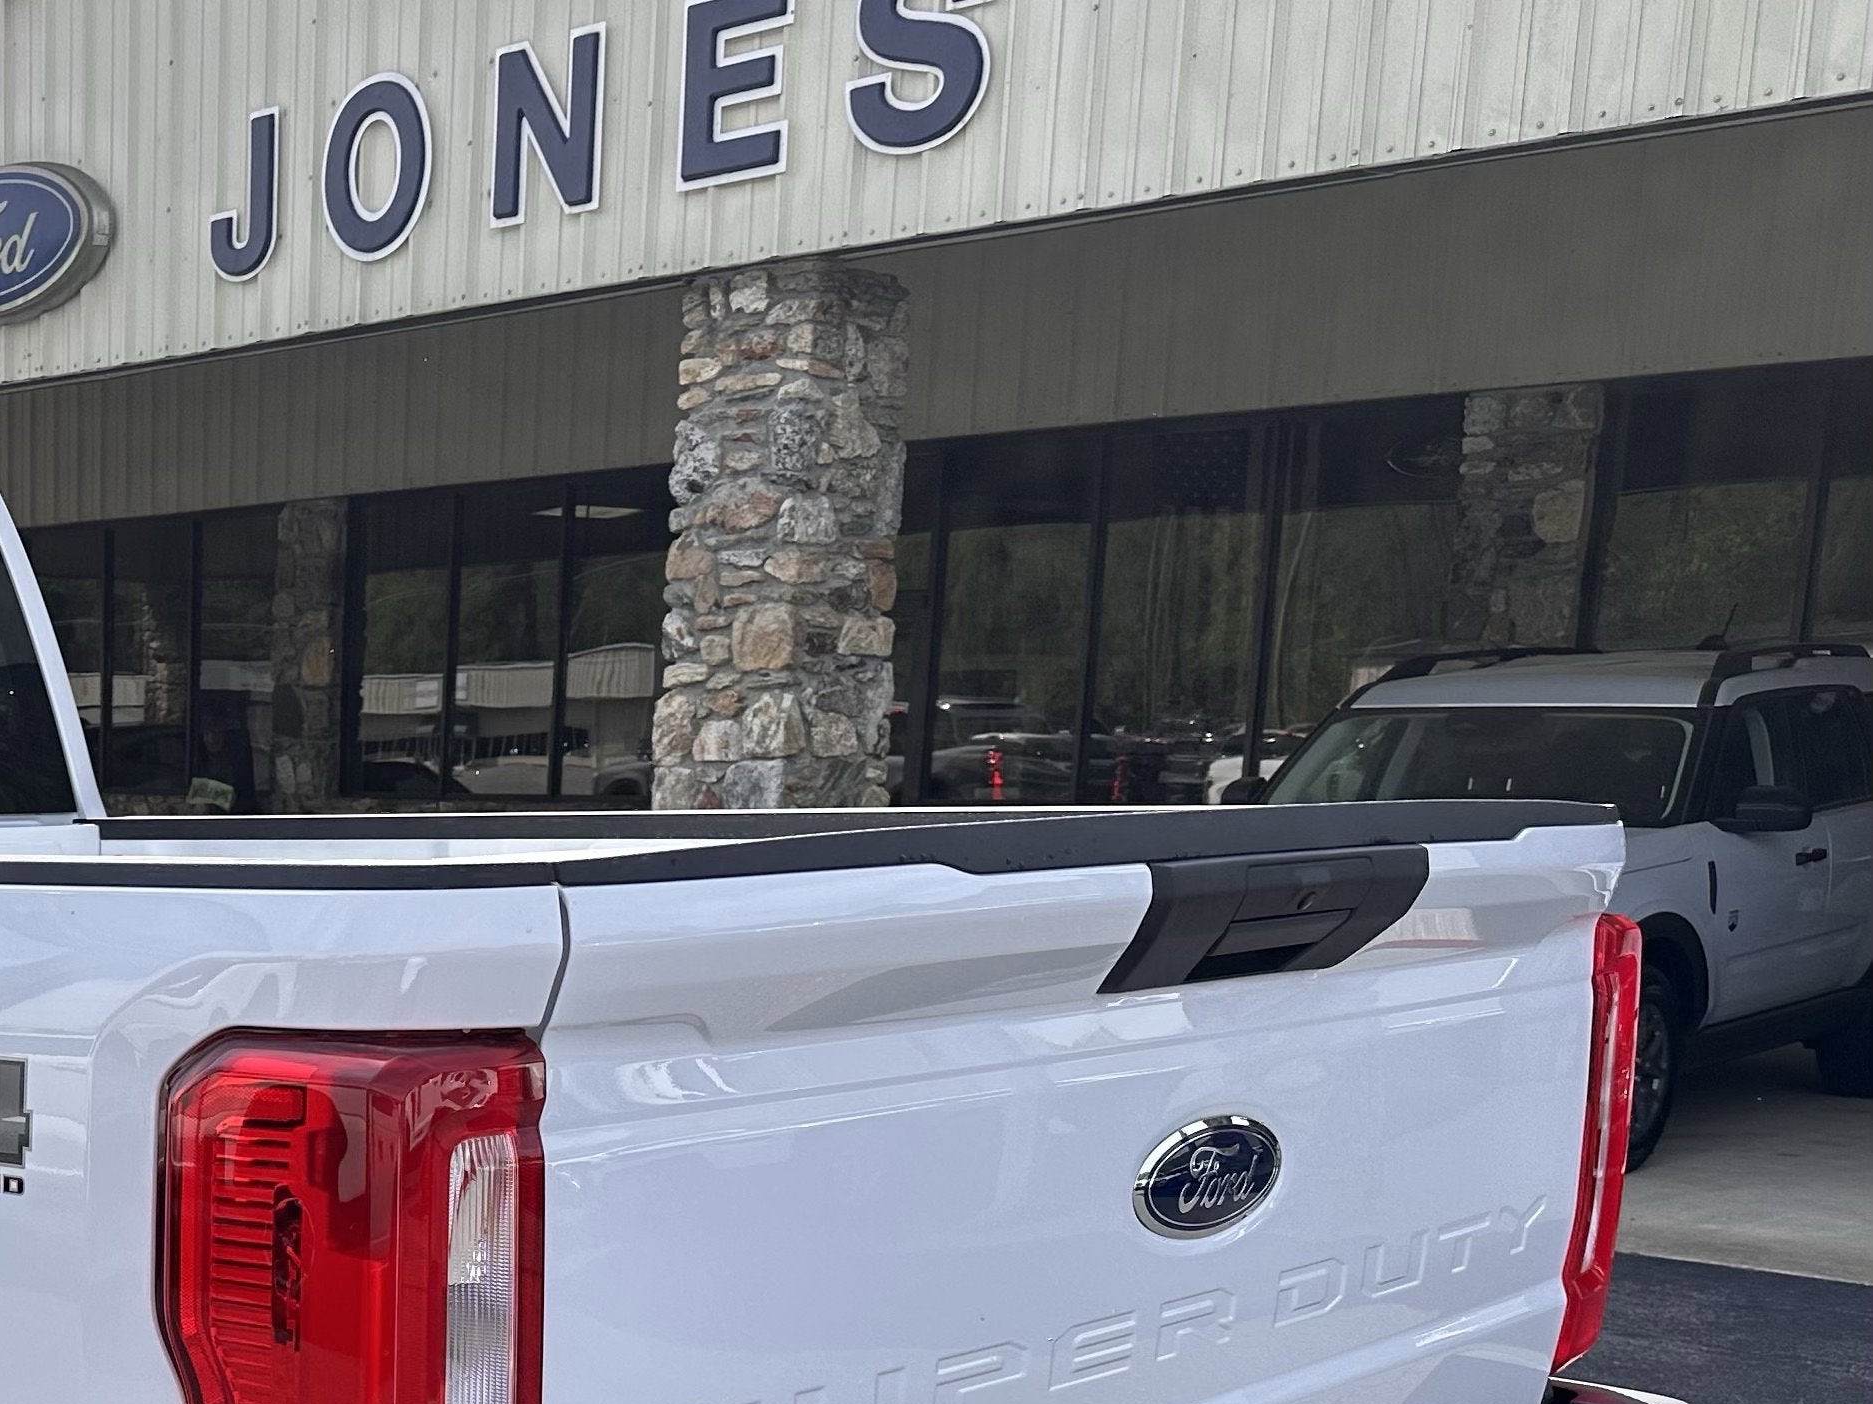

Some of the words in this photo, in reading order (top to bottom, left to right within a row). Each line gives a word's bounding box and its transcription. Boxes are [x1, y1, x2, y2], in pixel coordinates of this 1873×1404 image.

[210, 0, 991, 282] JONES
[1178, 1143, 1256, 1214] Ford
[1272, 1193, 1549, 1330] DUTY
